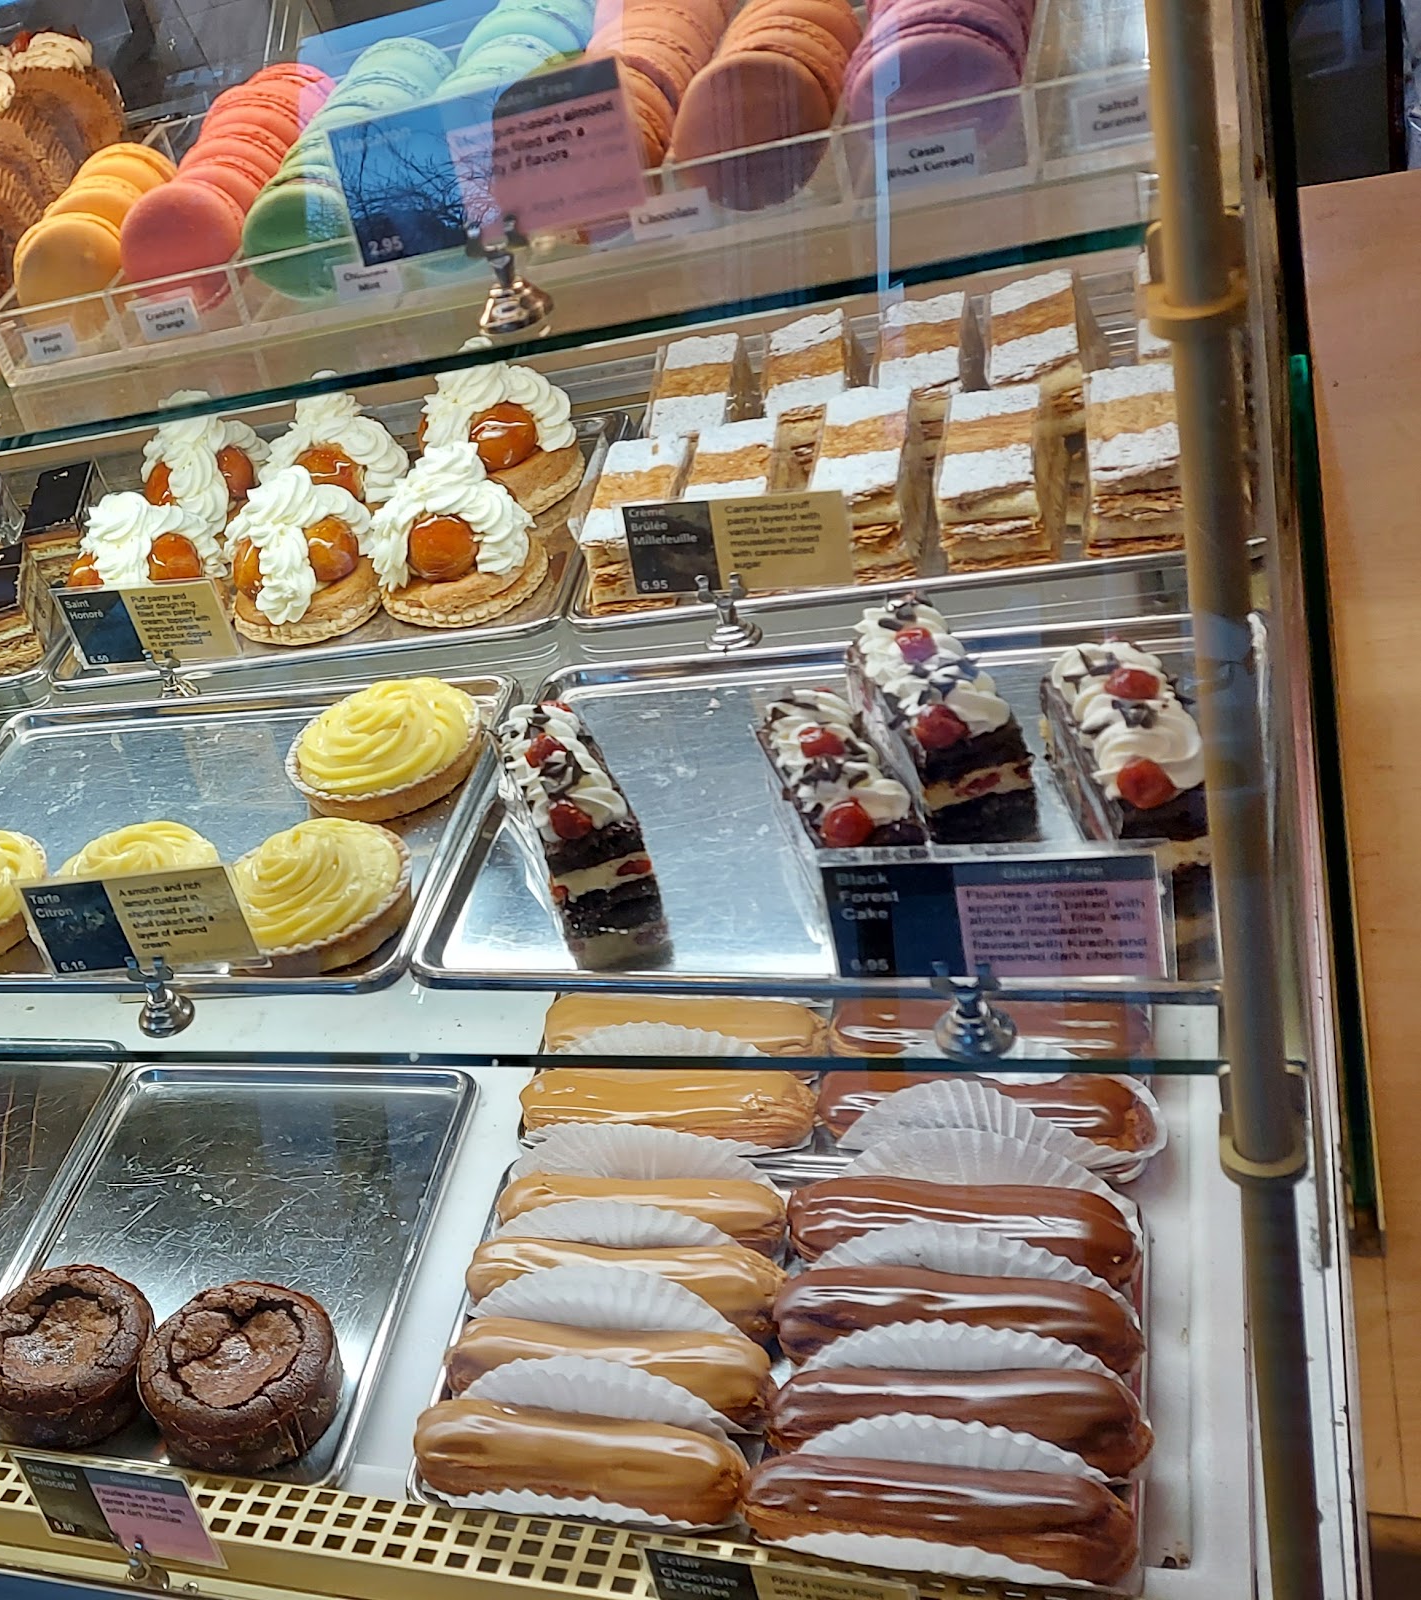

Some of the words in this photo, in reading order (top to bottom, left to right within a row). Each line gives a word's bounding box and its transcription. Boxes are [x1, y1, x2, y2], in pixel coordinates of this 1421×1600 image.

[1096, 97, 1140, 115] Salted
[908, 144, 945, 159] Cassis
[924, 152, 975, 171] Currant)
[367, 235, 404, 256] 2.95
[155, 318, 185, 333] Orange
[33, 330, 62, 344] Passion
[43, 343, 62, 355] Fruit
[725, 502, 788, 514] Caramelized
[790, 501, 810, 509] puff
[727, 516, 757, 526] pastry
[759, 513, 797, 523] layered
[799, 512, 820, 520] with
[631, 520, 669, 532] Brûlée
[633, 533, 698, 545] Millefeuille
[732, 550, 753, 558] with
[641, 580, 669, 590] 6.95
[65, 600, 90, 609] Saint
[70, 609, 104, 620] Honoré
[89, 655, 109, 663] 6.50
[836, 872, 889, 886] Black
[119, 889, 126, 897] A
[127, 887, 163, 896] smooth
[165, 883, 182, 891] and
[184, 881, 201, 890] rich
[29, 894, 61, 905] Tarte
[839, 891, 900, 903] Forest
[35, 906, 74, 919] Citron
[841, 908, 888, 920] Cake
[173, 926, 208, 935] almond
[60, 960, 87, 972] 6.15
[63, 1472, 77, 1480] au
[32, 1476, 77, 1492] Chocolat
[660, 1567, 739, 1587] Chocolate
[663, 1578, 676, 1590] &
[681, 1583, 730, 1598] Coffee
